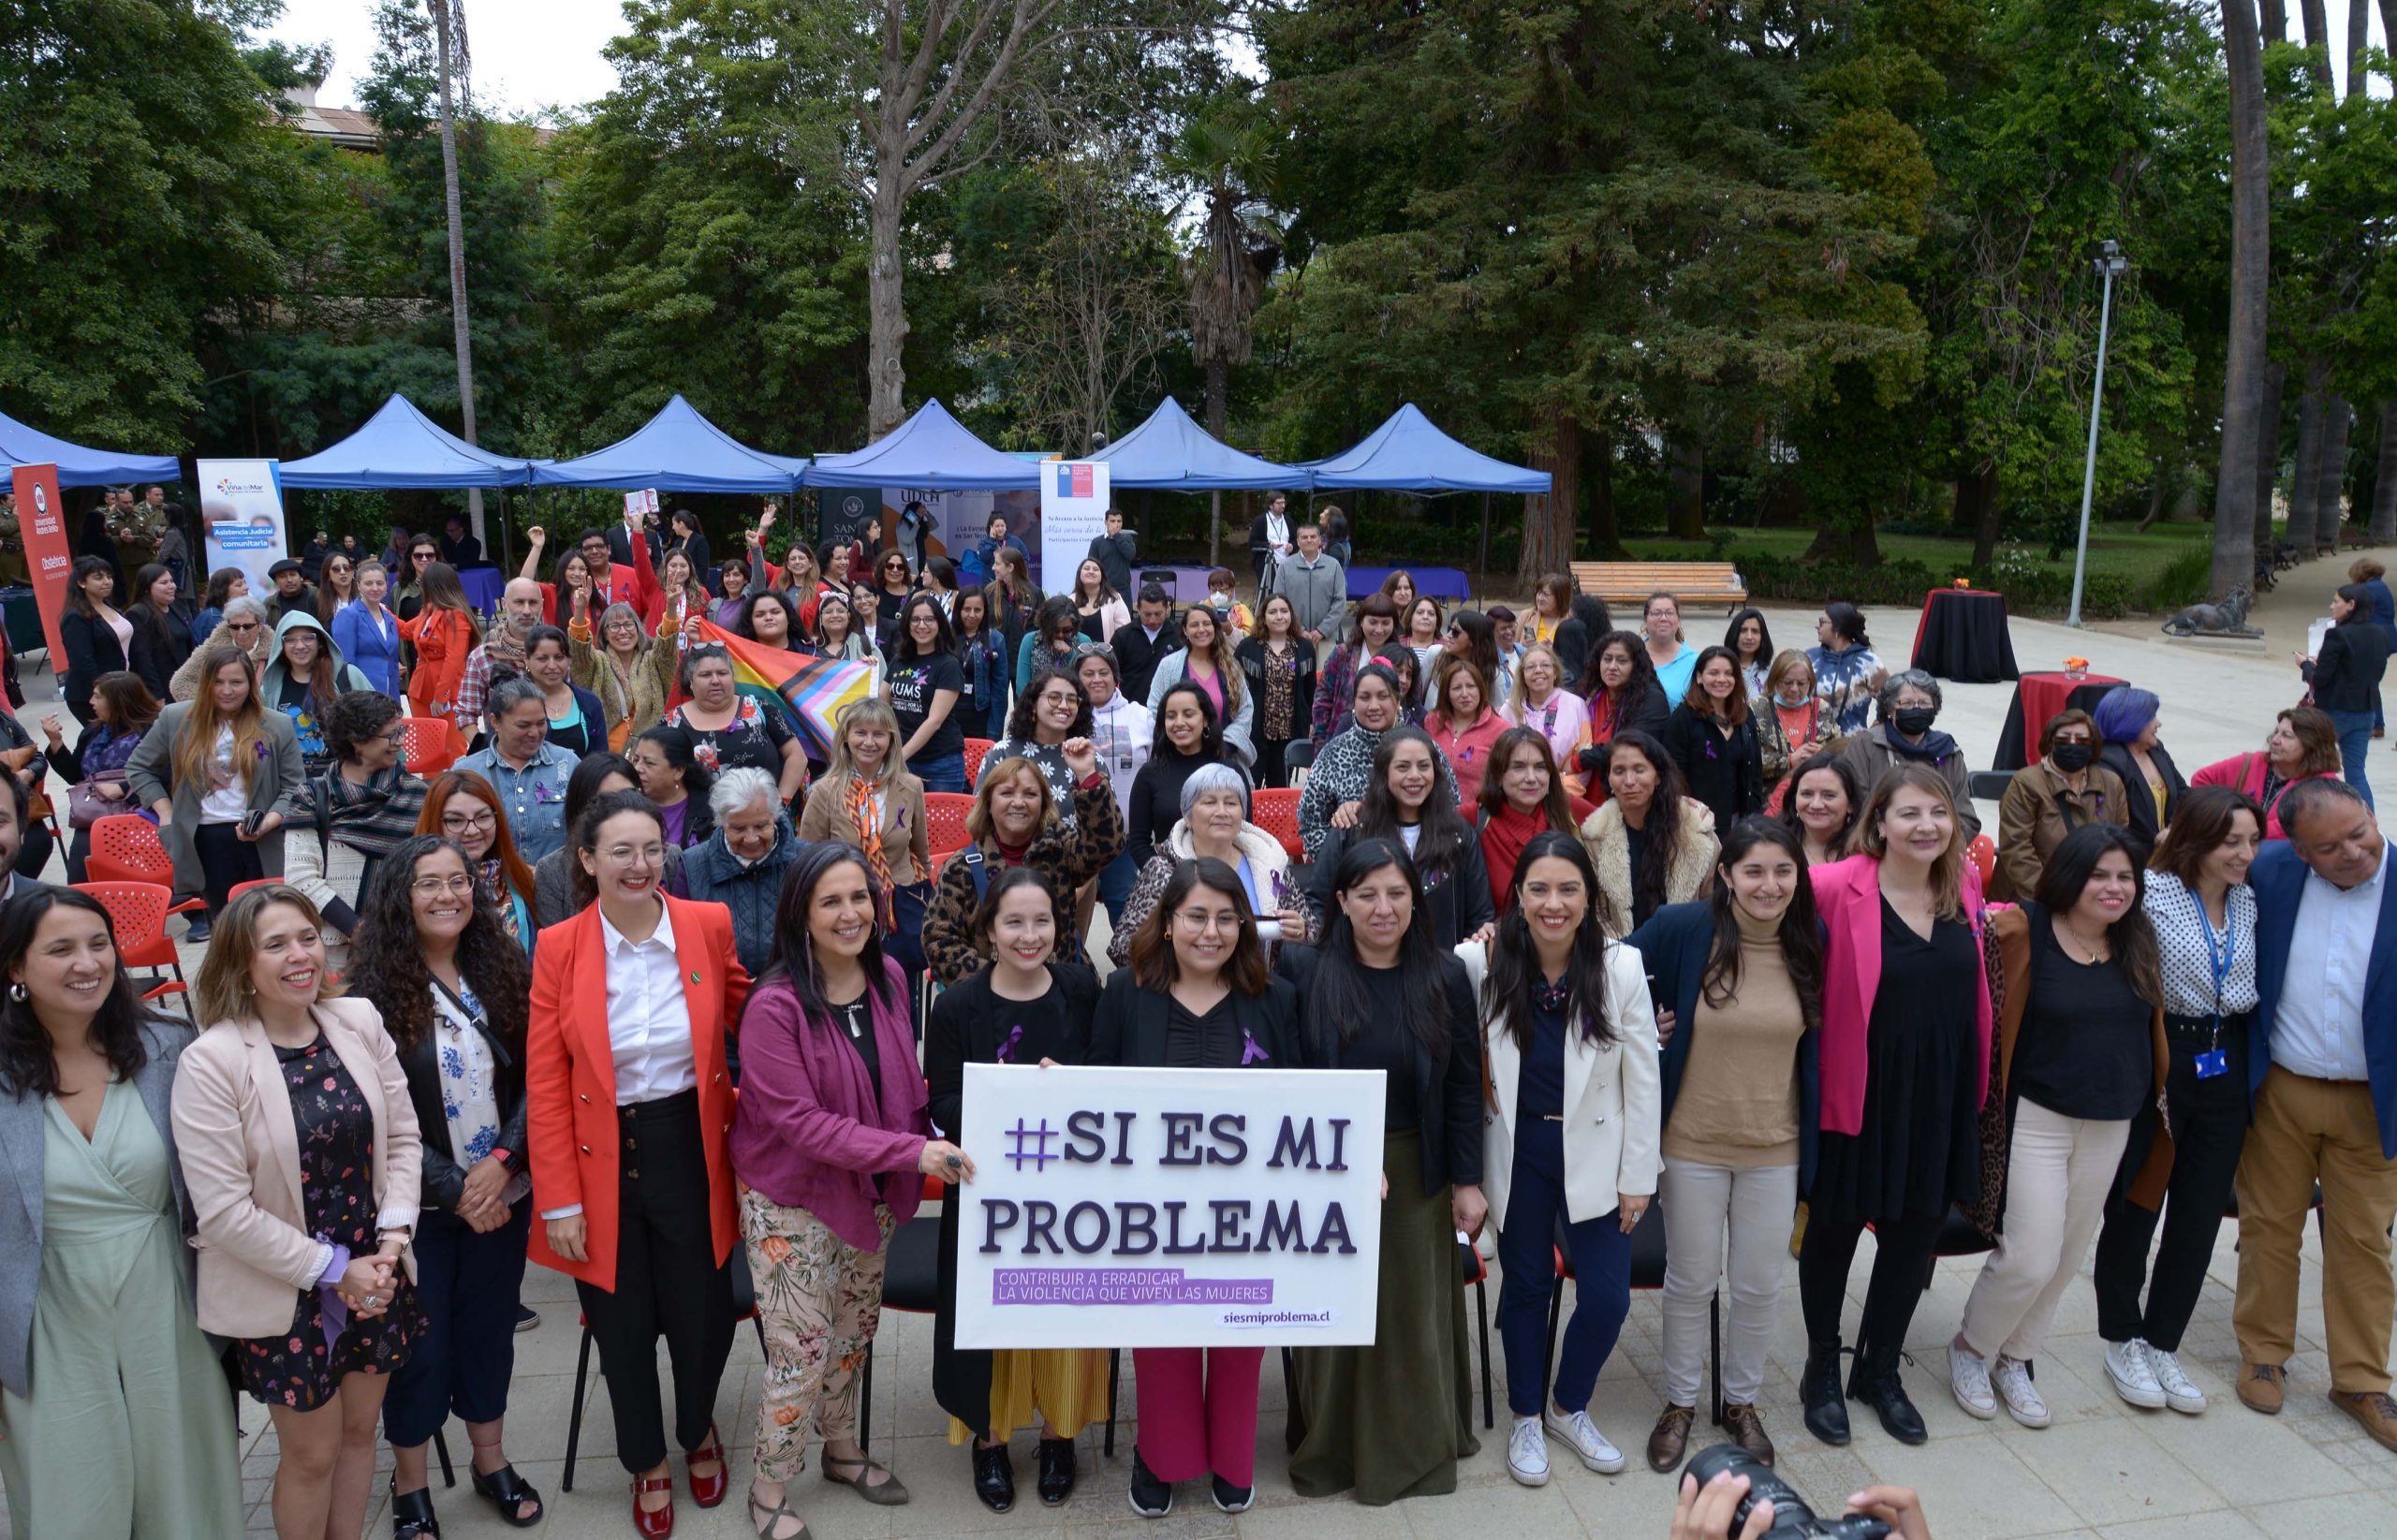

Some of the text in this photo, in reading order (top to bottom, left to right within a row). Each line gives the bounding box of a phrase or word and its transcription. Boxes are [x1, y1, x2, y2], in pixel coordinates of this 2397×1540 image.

[833, 524, 857, 534] SAN
[222, 539, 268, 548] comunitaria
[1005, 1110, 1351, 1172] #SI ES MI
[978, 1198, 1358, 1255] PROBLEMA
[999, 1271, 1180, 1286] CONTRIBUIR A ERRADICAR
[998, 1286, 1268, 1302] LA VIOLENCIA QUE VIVEN LAS MUJERES
[1223, 1311, 1331, 1326] siesmiproblema.cl
